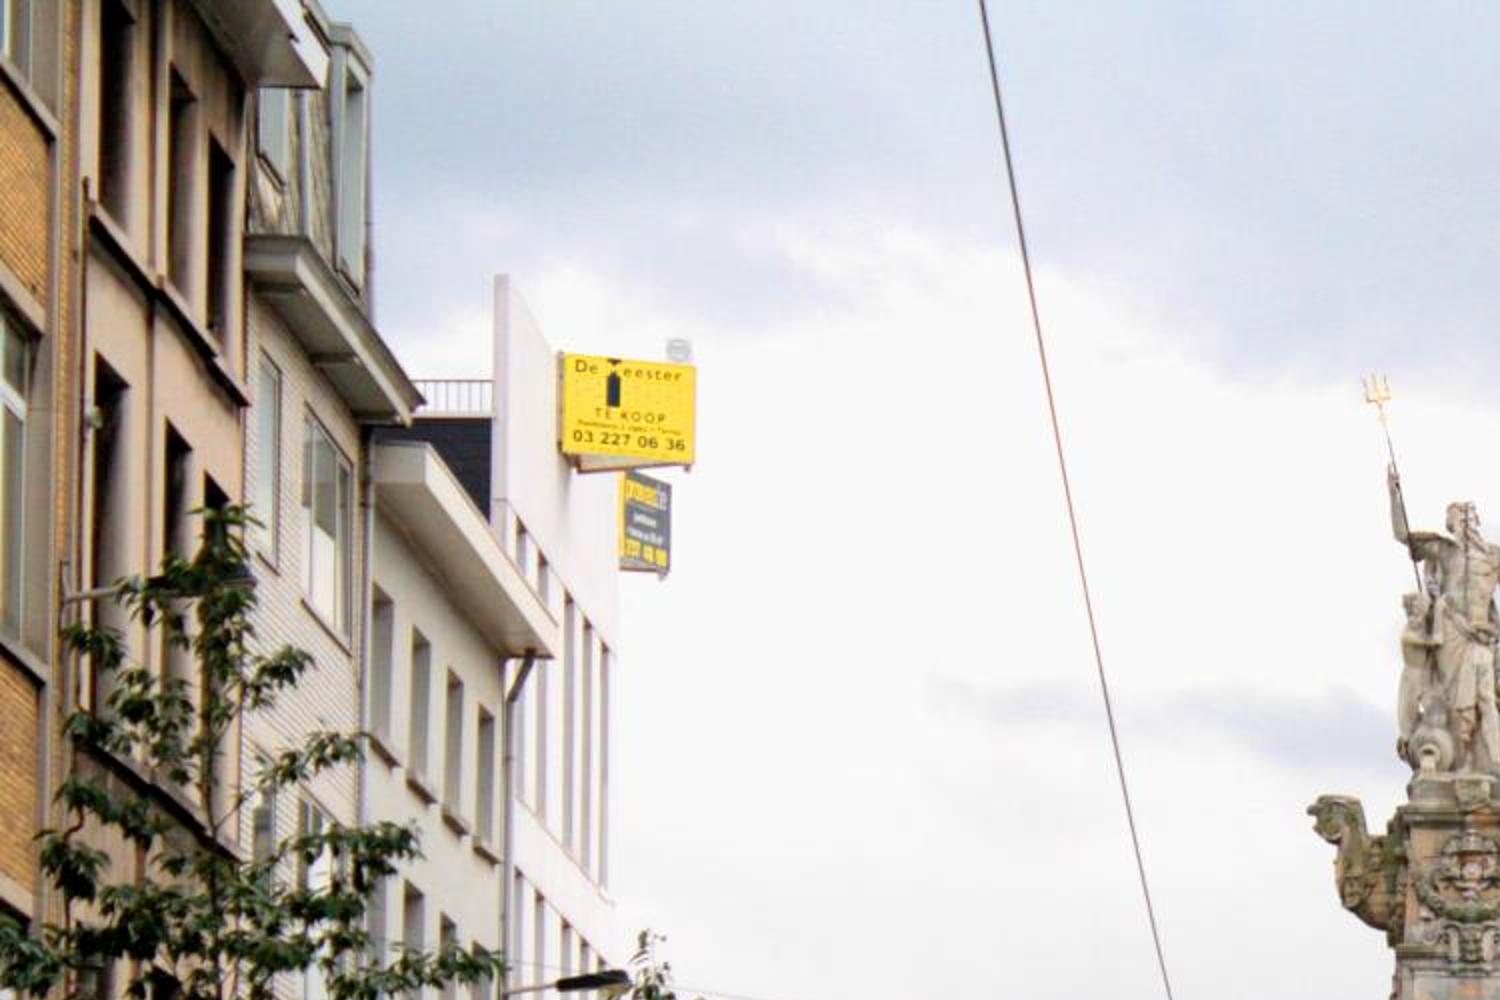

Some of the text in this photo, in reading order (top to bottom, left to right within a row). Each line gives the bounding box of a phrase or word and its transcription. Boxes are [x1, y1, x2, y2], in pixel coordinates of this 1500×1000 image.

[574, 359, 600, 375] De
[620, 411, 667, 424] KOOP
[573, 430, 686, 452] 03 227 06 36
